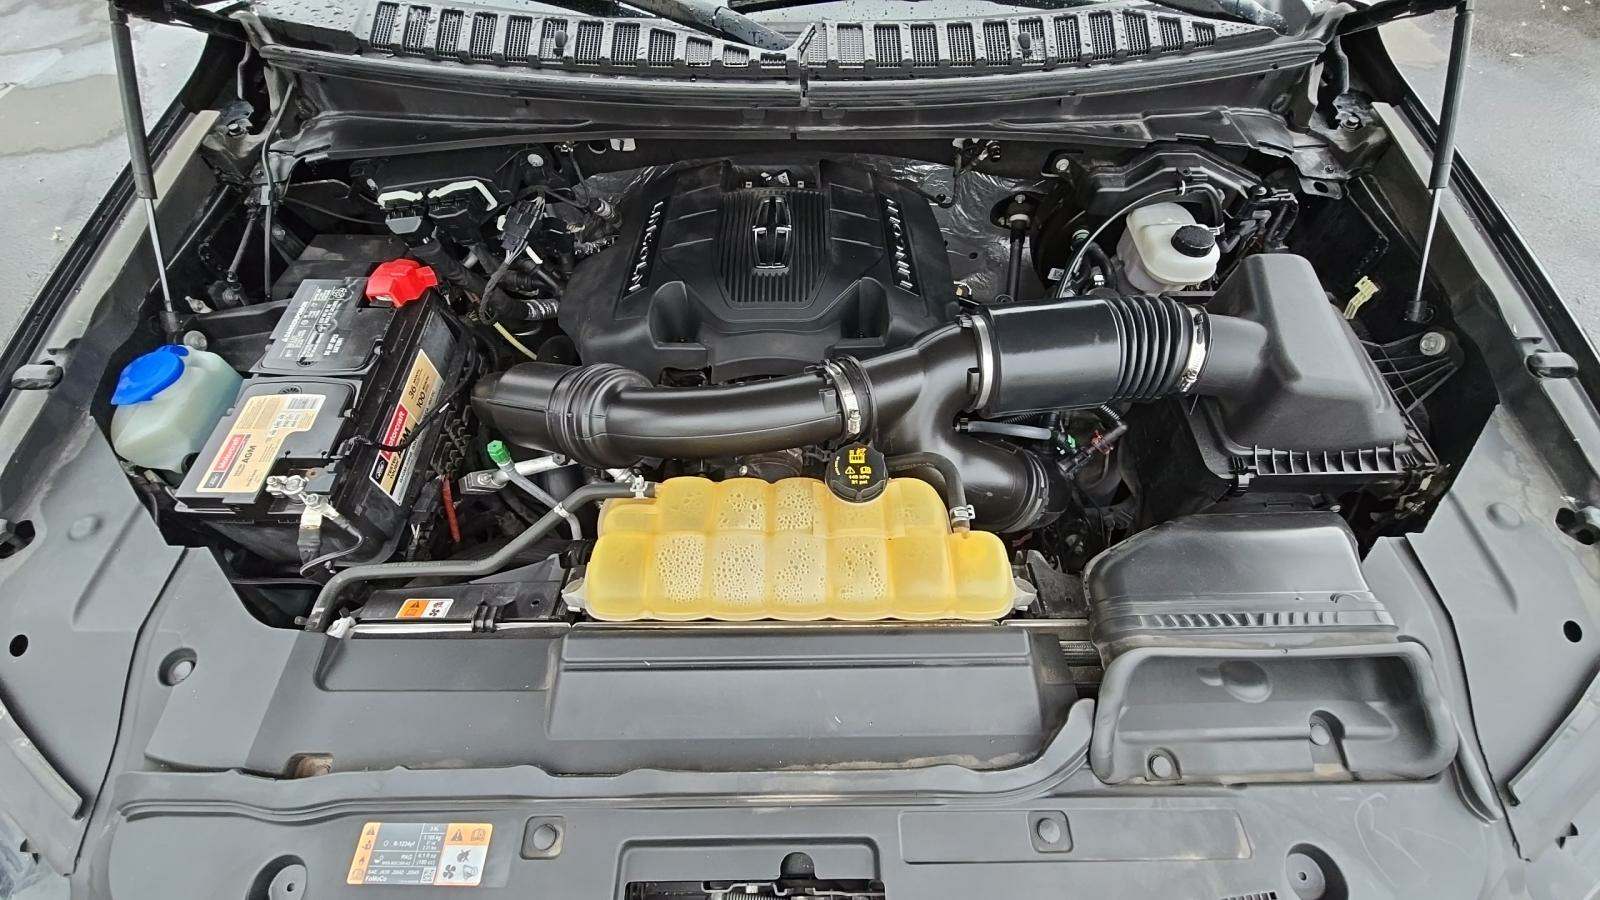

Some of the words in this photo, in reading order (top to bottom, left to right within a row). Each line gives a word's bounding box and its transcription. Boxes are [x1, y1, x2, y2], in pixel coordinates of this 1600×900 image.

[628, 201, 664, 291] LINCOLN
[416, 391, 426, 408] 100
[242, 445, 257, 464] AGM
